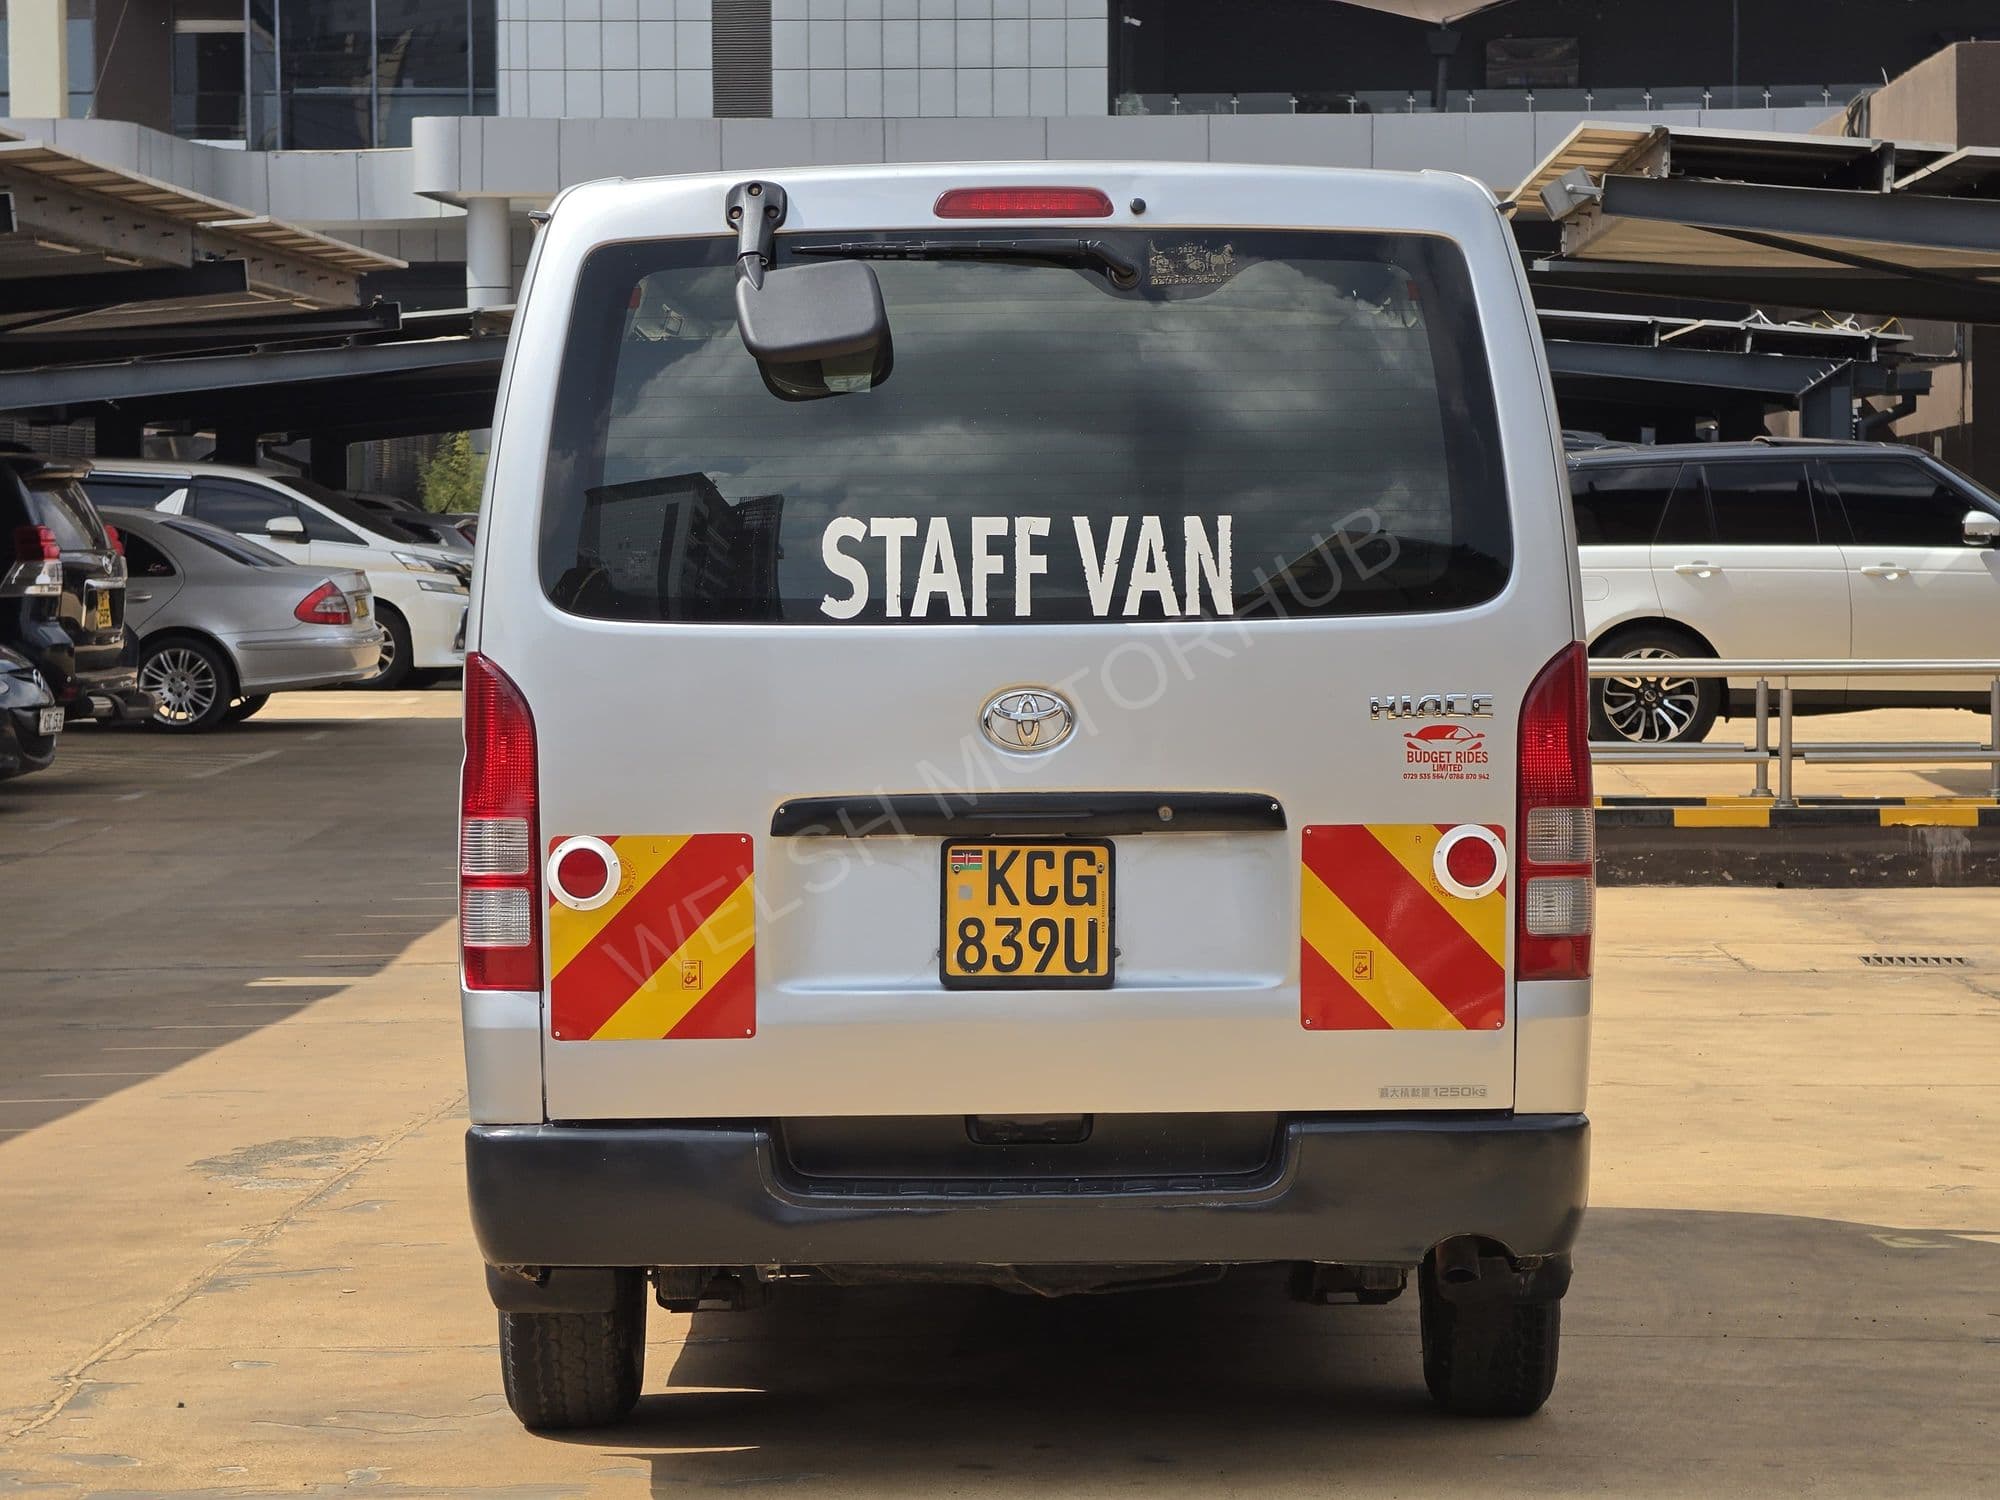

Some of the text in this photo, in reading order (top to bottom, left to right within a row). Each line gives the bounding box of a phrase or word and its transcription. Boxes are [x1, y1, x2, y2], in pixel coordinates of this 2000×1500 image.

[820, 515, 1234, 620] STAFF VAN
[1370, 693, 1494, 720] HIACE
[1407, 751, 1489, 763] BUDGET RIDES
[1432, 764, 1463, 772] LIMITED
[652, 845, 659, 853] L
[1415, 836, 1422, 844] R
[987, 850, 1098, 906] KCG
[957, 917, 1098, 973] 839U
